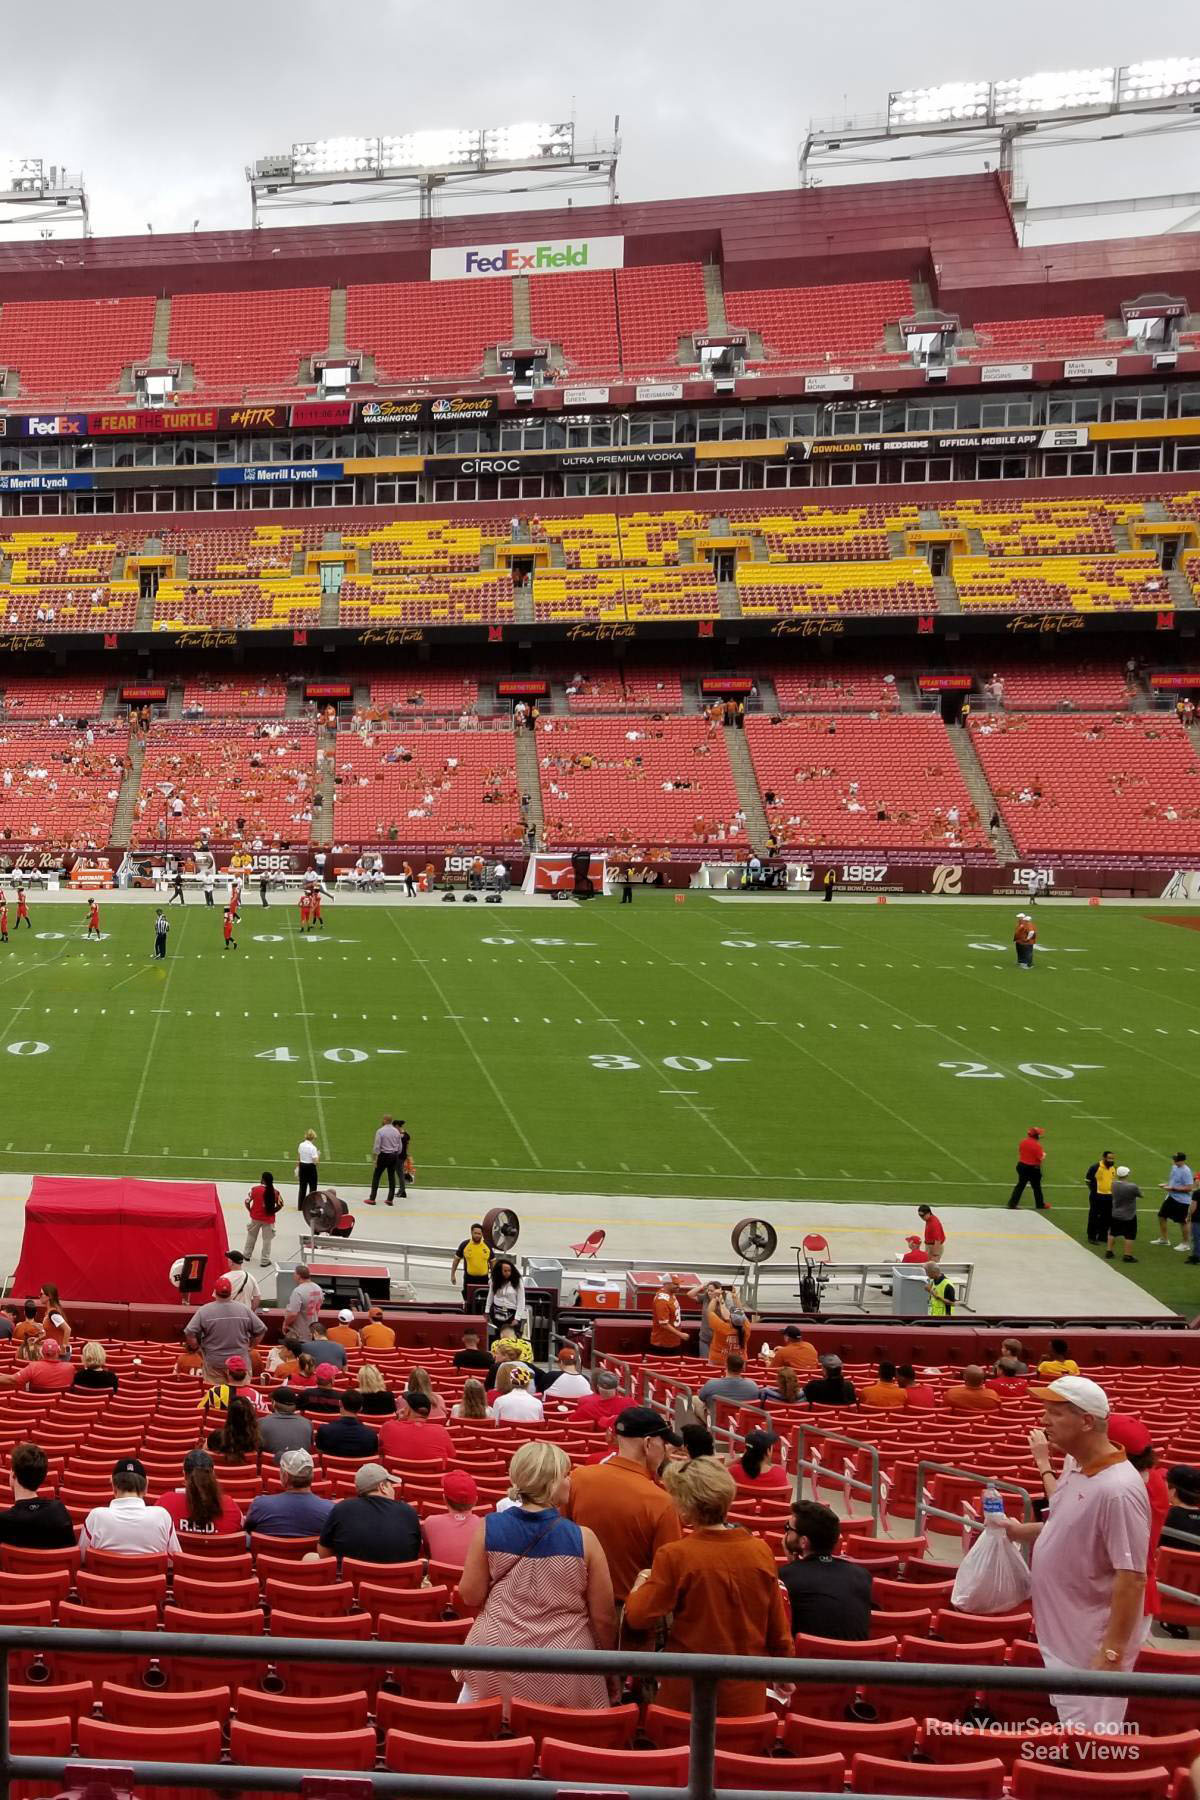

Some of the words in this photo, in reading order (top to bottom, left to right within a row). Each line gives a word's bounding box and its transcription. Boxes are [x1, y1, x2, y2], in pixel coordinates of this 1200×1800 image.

[466, 244, 588, 273] FedExField
[380, 401, 422, 415] Sports
[450, 398, 492, 412] Sports
[230, 409, 276, 428] #HTTR
[363, 413, 417, 423] WASHINGTON
[433, 410, 488, 421] WASHINGTON
[29, 416, 79, 435] FedEx
[812, 444, 862, 454] DOWNLOAD
[863, 442, 880, 451] THE
[883, 441, 929, 450] REDSKINS
[939, 438, 980, 448] OFFICIAL
[981, 437, 1016, 446] MOBILE
[1017, 435, 1037, 444] APP
[461, 458, 520, 473] CÎROC
[562, 457, 594, 465] ULTRA
[597, 455, 644, 463] PREMIUM
[647, 453, 684, 461] VODKA
[257, 468, 288, 480] Merrill
[291, 468, 318, 480] Lynch
[10, 478, 40, 488] Merrill
[42, 477, 68, 489] Lynch
[253, 855, 290, 870] 1982
[842, 866, 888, 882] 1987
[179, 1518, 219, 1533] R.E.D.
